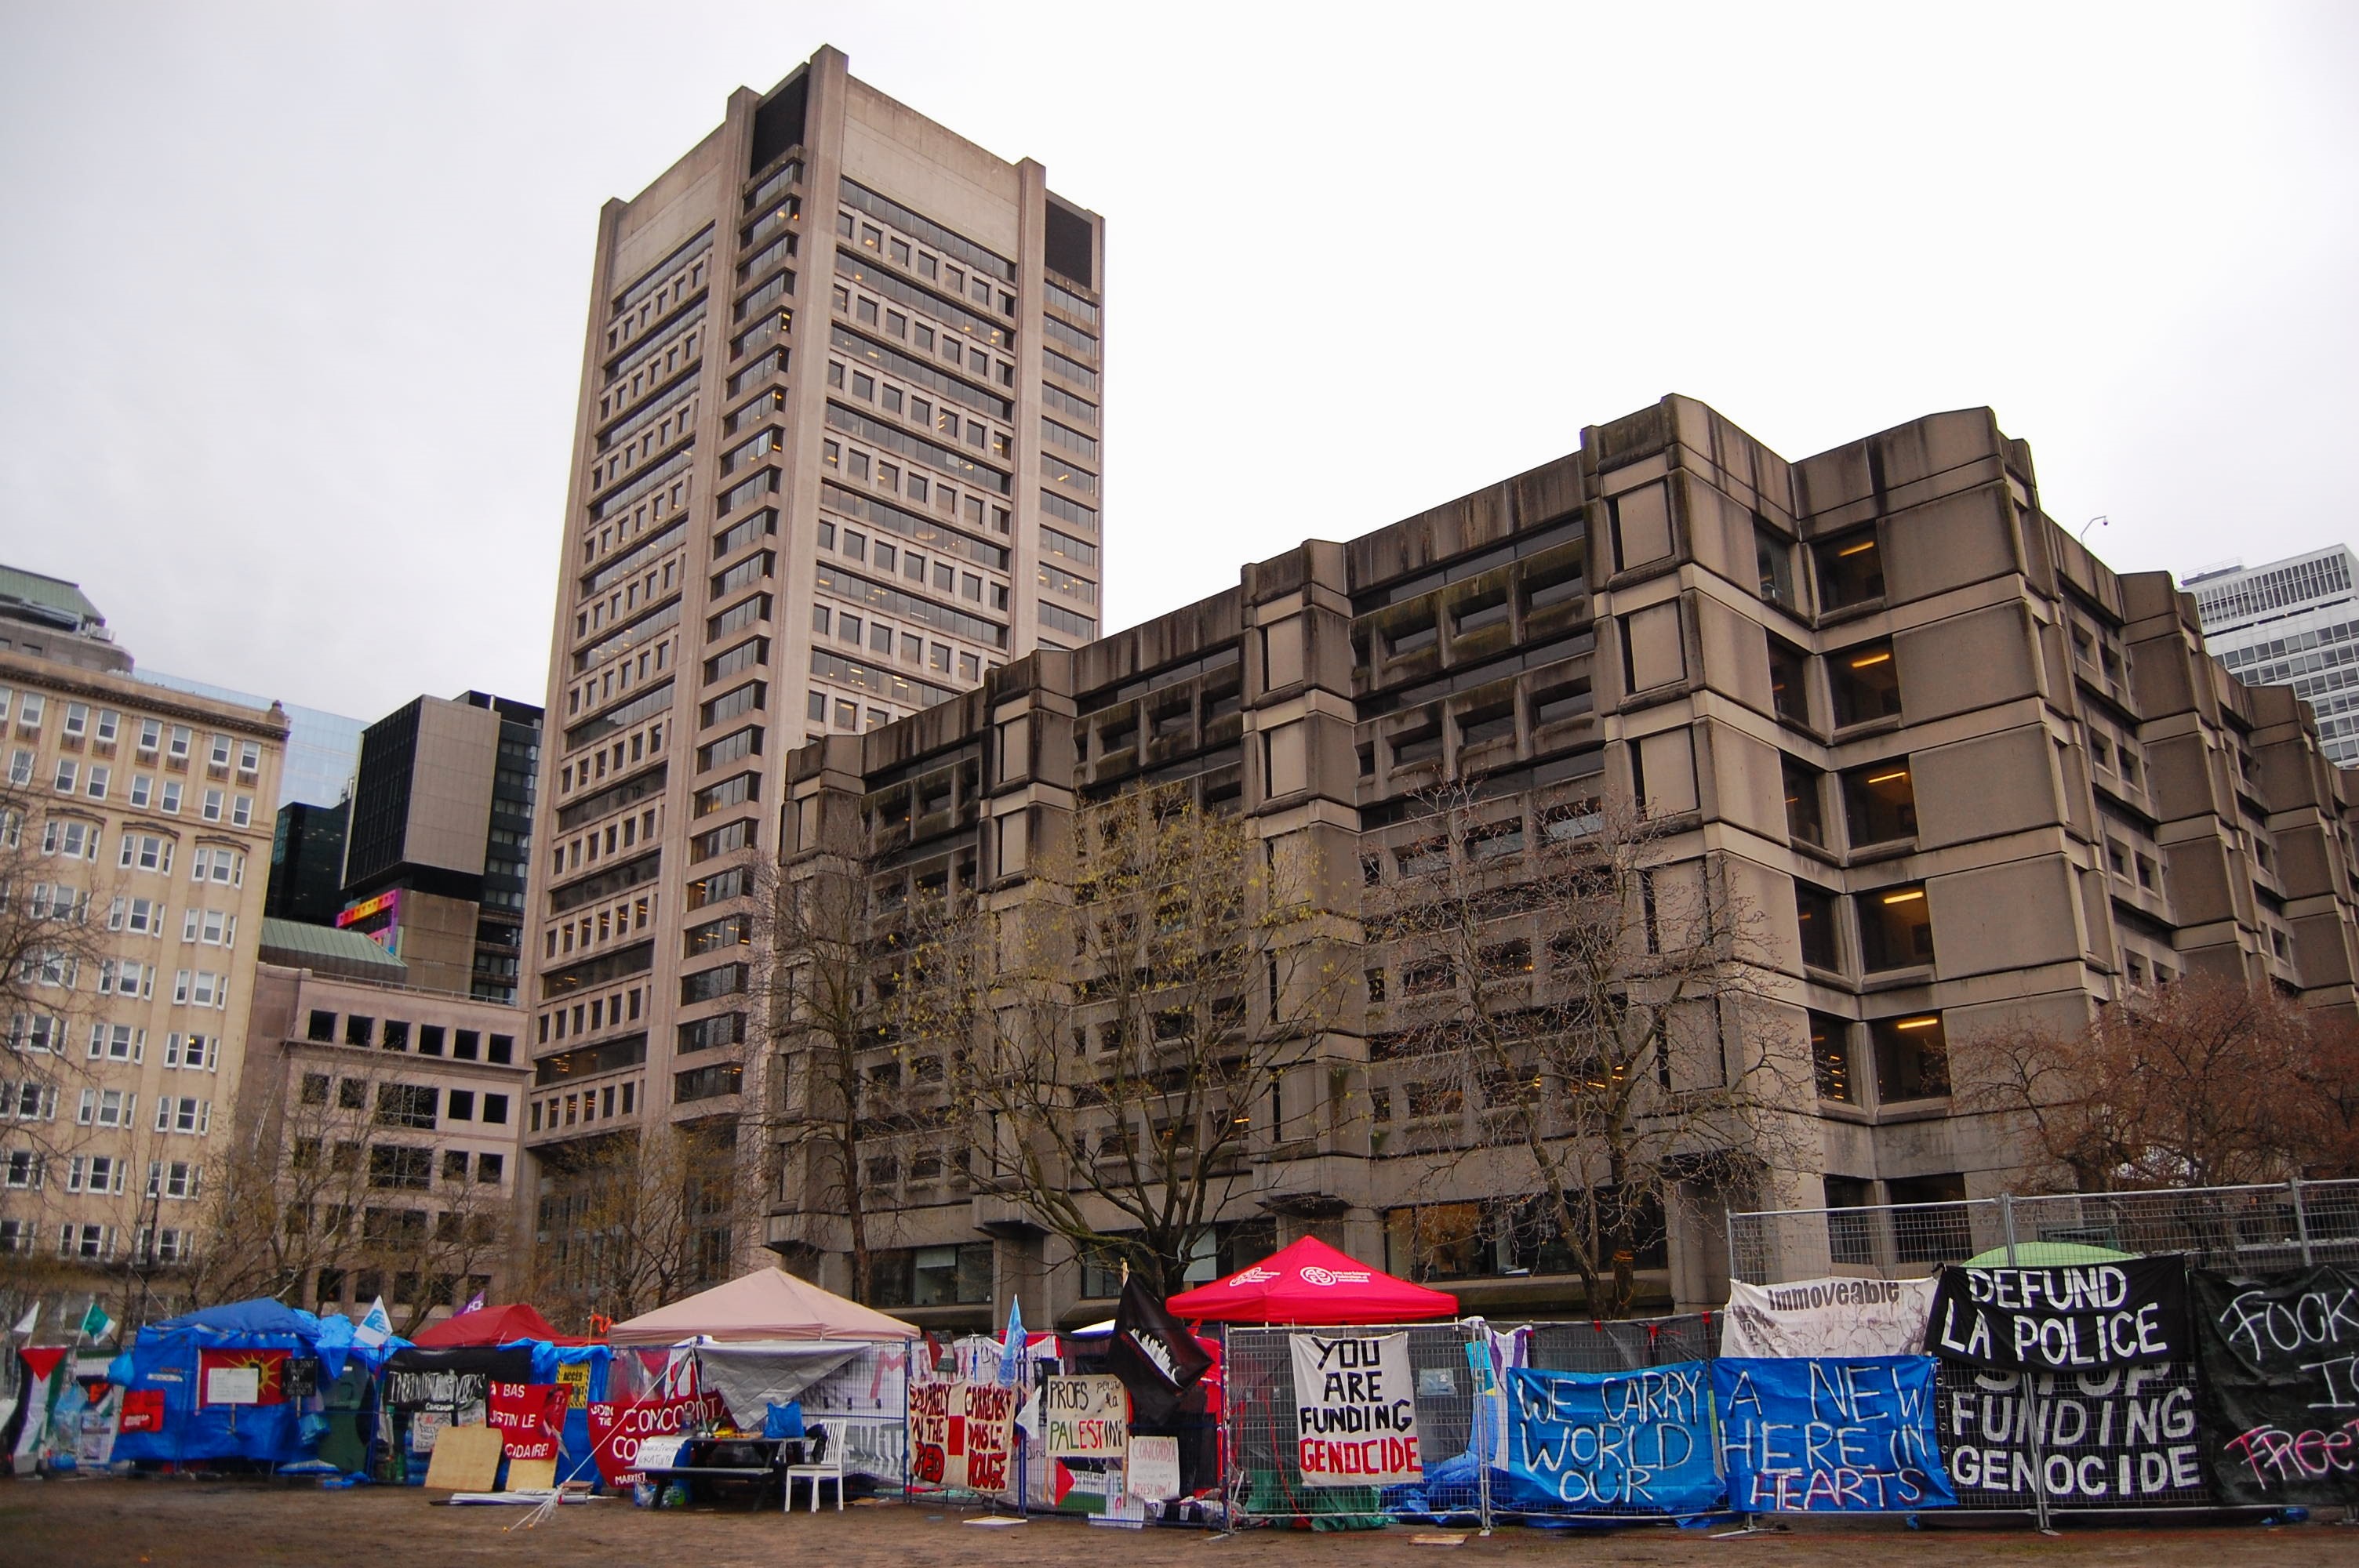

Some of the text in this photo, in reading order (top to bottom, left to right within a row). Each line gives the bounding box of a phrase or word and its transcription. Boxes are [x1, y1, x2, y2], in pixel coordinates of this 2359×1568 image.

[1767, 1280, 1899, 1311] Immoveable
[1965, 1265, 2127, 1310] DEFUND
[1940, 1297, 2167, 1365] LA POLICE
[2219, 1288, 2359, 1361] FUCK
[1311, 1337, 1380, 1370] YOU
[503, 1384, 525, 1398] BAS
[1049, 1381, 1089, 1410] PROFS
[1324, 1370, 1383, 1403] ARE
[1517, 1370, 1702, 1424] WE CARRY
[1728, 1361, 1936, 1423] A NEW
[522, 1414, 536, 1428] LE
[590, 1404, 614, 1416] JOIN
[598, 1417, 612, 1427] THE
[1299, 1399, 1412, 1434] FUNDING
[1952, 1386, 2195, 1446] FUNDING
[927, 1417, 943, 1443] THE
[1049, 1419, 1122, 1450] PALESTINE
[1520, 1422, 1693, 1472] WORLD
[1719, 1419, 1928, 1474] HERE IN
[914, 1441, 945, 1484] RED
[968, 1448, 1007, 1490] ROUGE
[1299, 1436, 1423, 1475] GENOCIDE
[1952, 1445, 2201, 1495] GENOCIDE
[1559, 1468, 1654, 1503] OUR
[1750, 1468, 1925, 1511] HEARTS
